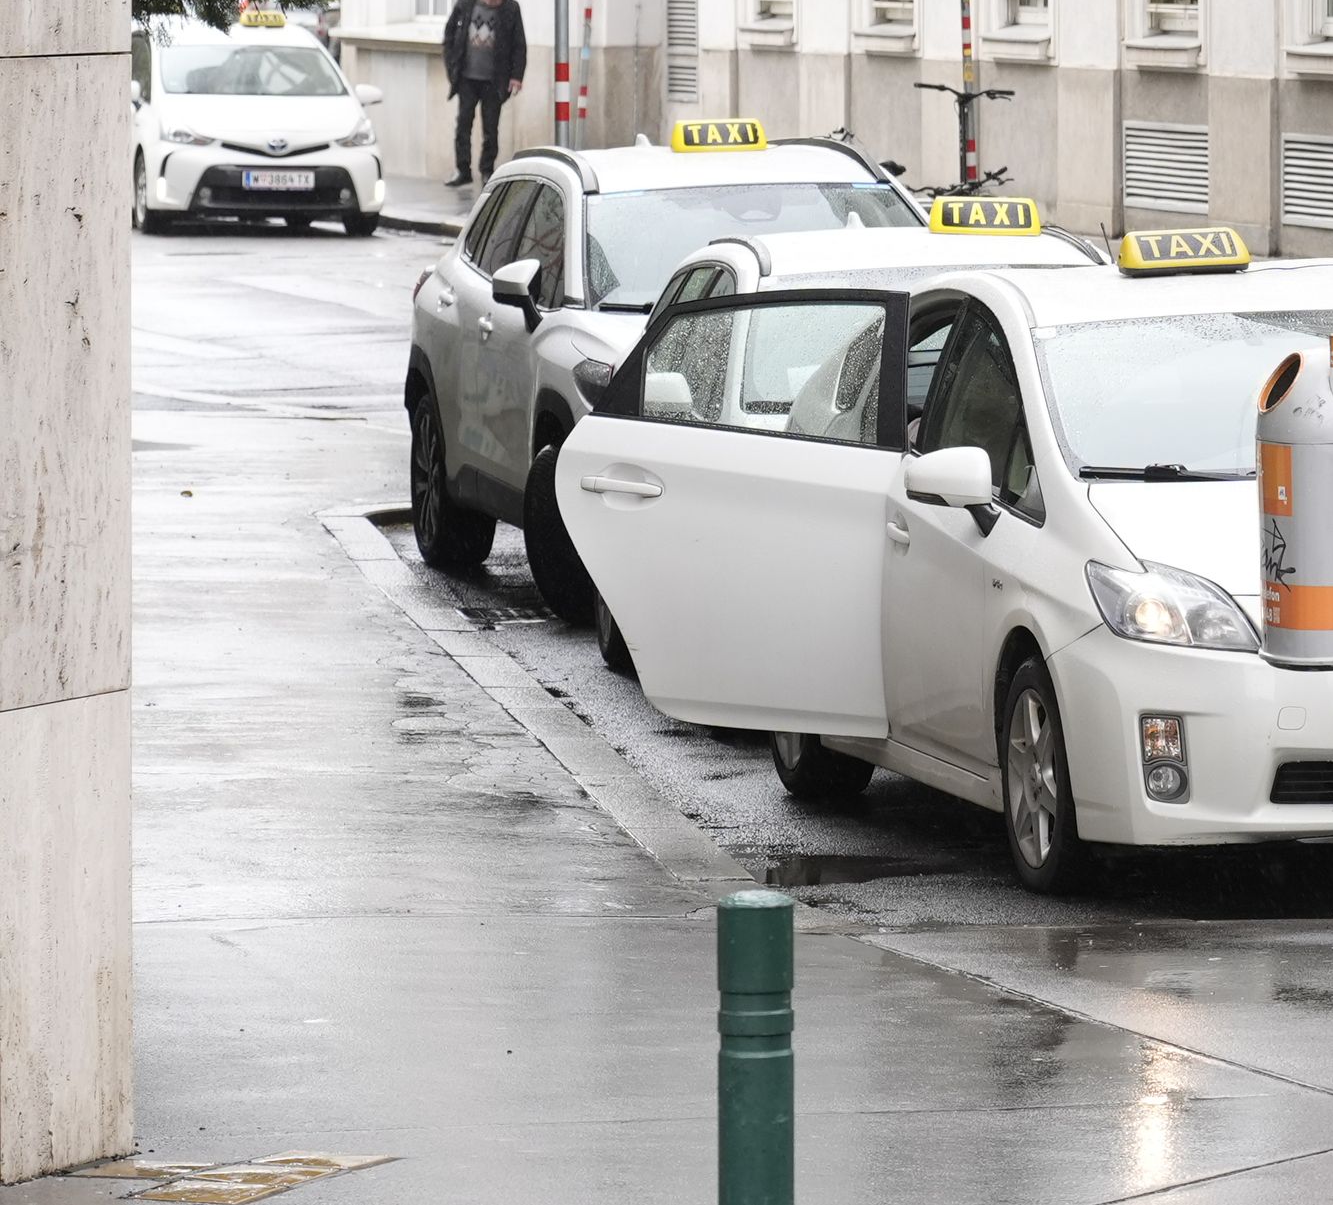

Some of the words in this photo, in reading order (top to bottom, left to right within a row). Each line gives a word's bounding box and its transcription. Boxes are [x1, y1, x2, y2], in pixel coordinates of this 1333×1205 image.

[688, 123, 757, 145] TAXI
[948, 202, 1025, 227] TAXI
[1140, 231, 1232, 260] TAXI
